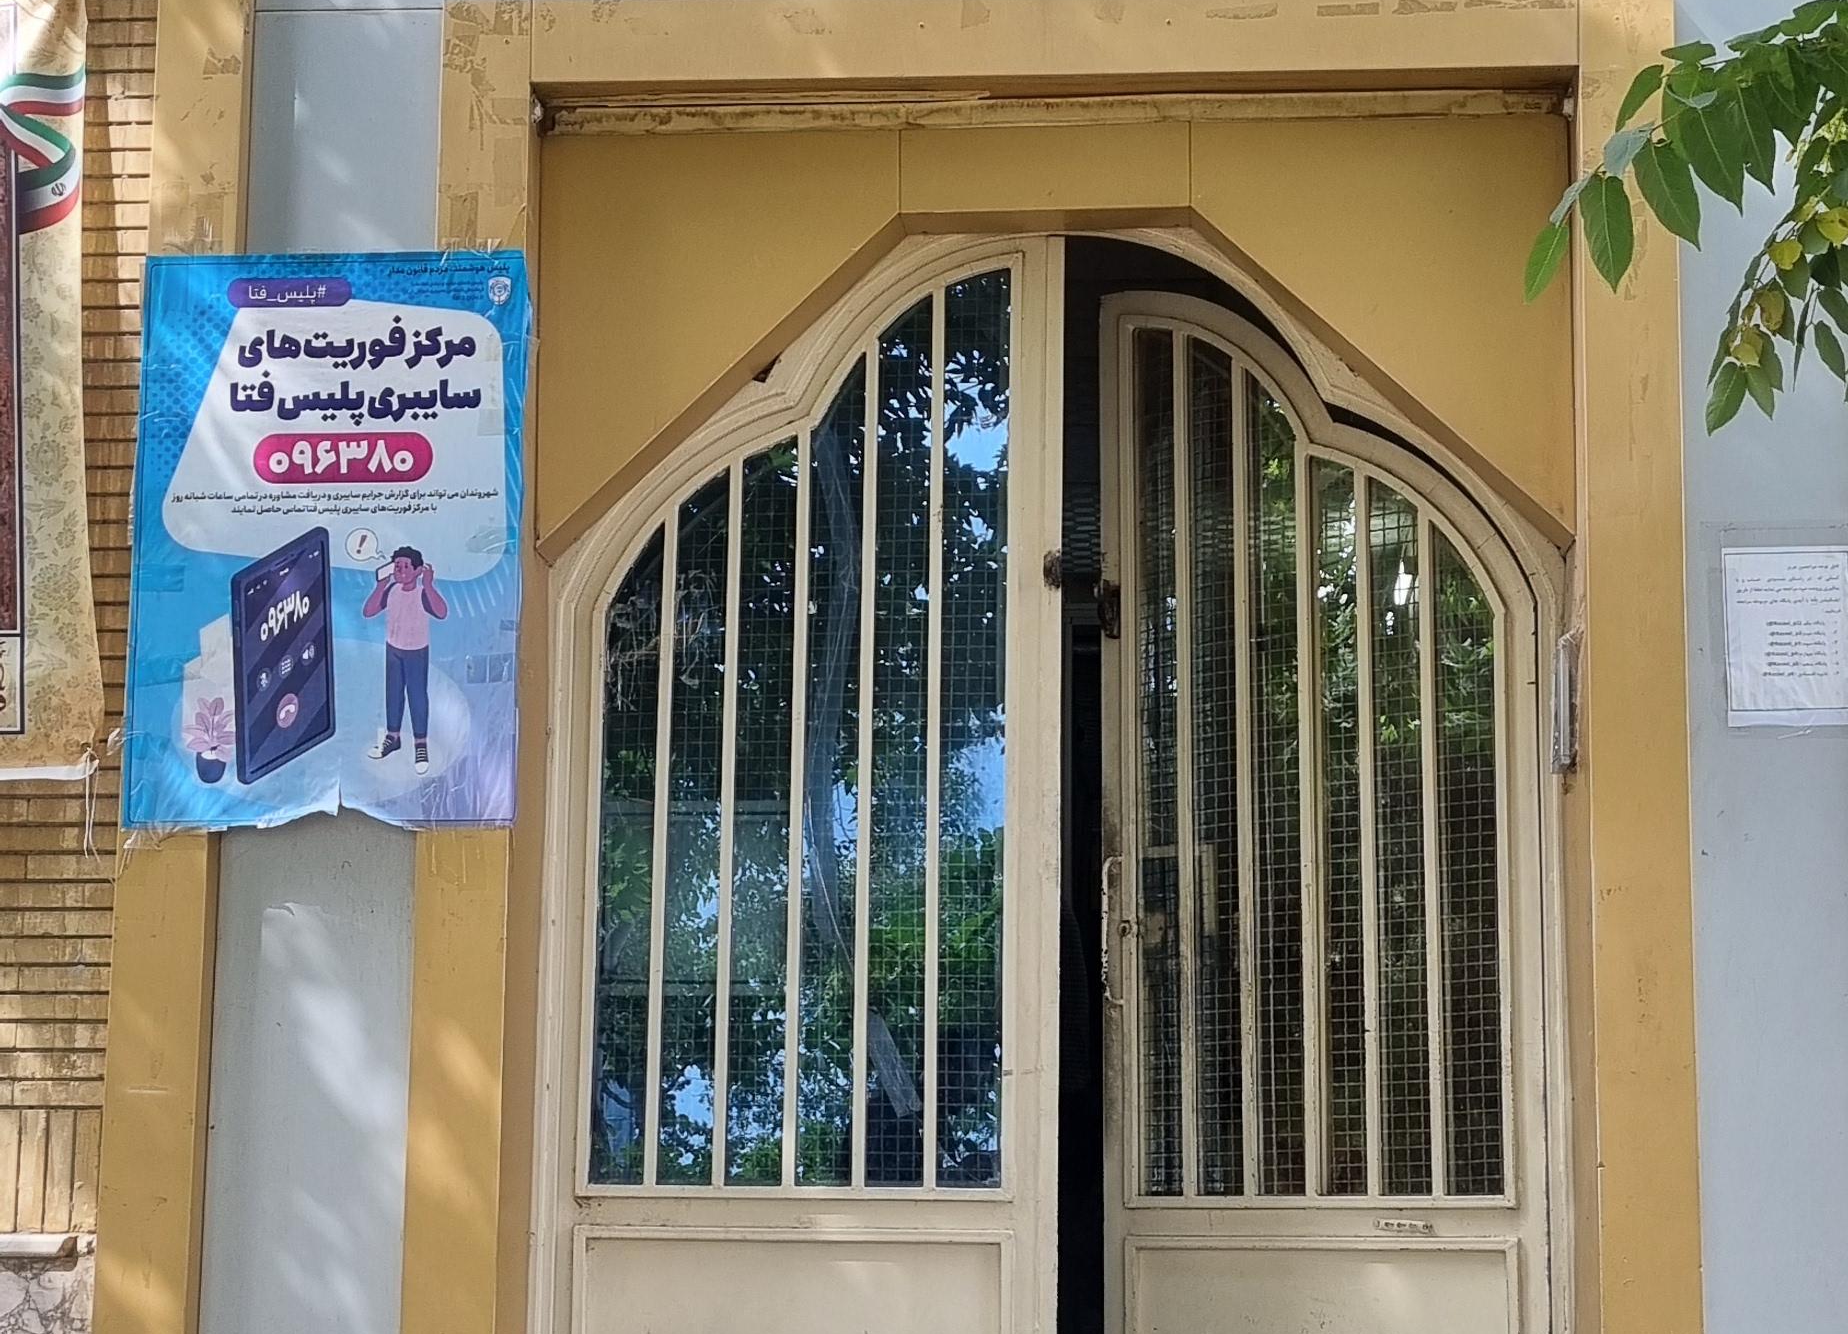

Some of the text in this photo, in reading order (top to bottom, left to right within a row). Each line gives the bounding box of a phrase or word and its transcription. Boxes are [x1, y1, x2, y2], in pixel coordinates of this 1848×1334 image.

[248, 284, 327, 304] #پلیس_فتا
[405, 326, 477, 369] مرکز
[229, 370, 482, 427] سایبری پلیس فتا
[269, 437, 415, 475] ۰۹۶۳۸۰
[171, 492, 184, 503] روز
[184, 491, 207, 502] شبانه
[207, 491, 233, 501] ساعات
[234, 491, 259, 502] تمامی
[258, 492, 268, 503] در
[268, 491, 297, 503] مشاوره
[298, 488, 326, 503] دریافت
[332, 490, 361, 502] سایبری
[361, 490, 384, 502] جرایم
[384, 489, 408, 501] گزارش
[409, 489, 426, 501] برای
[460, 488, 499, 500] شهروندان
[231, 504, 256, 516] نمایند
[256, 504, 282, 515] حاصل
[305, 502, 318, 513] فتا
[317, 503, 341, 516] پلیس
[341, 504, 370, 515] سایبری
[412, 503, 430, 514] مرکز
[430, 503, 438, 515] با
[260, 590, 310, 642] ۰۹۶۳۸۰
